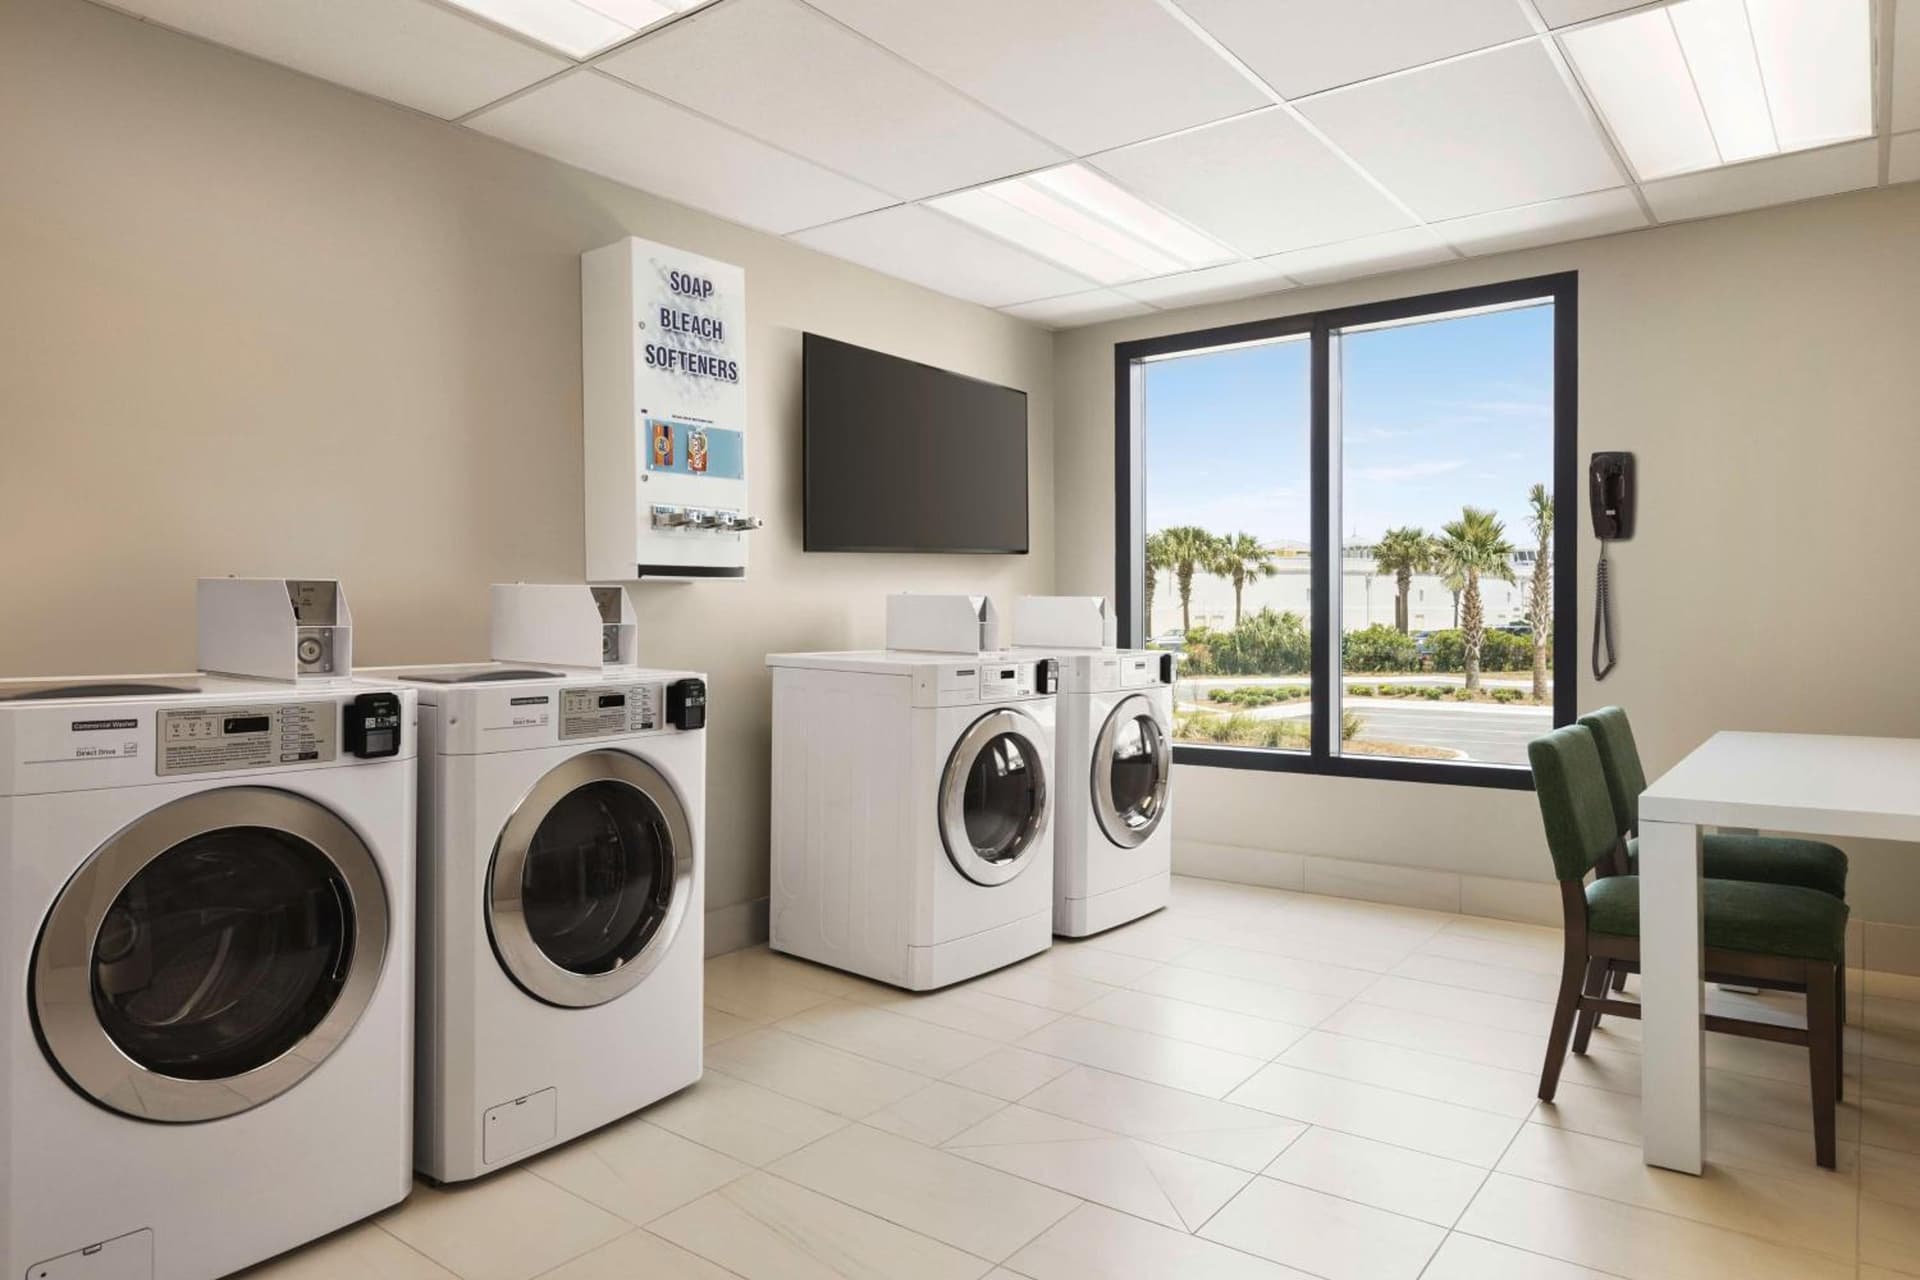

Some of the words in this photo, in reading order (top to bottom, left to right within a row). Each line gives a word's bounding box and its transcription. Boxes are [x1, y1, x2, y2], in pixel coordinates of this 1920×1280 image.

[670, 271, 713, 298] SOAP
[660, 307, 723, 340] BLEACH
[645, 344, 738, 381] SOFTENERS
